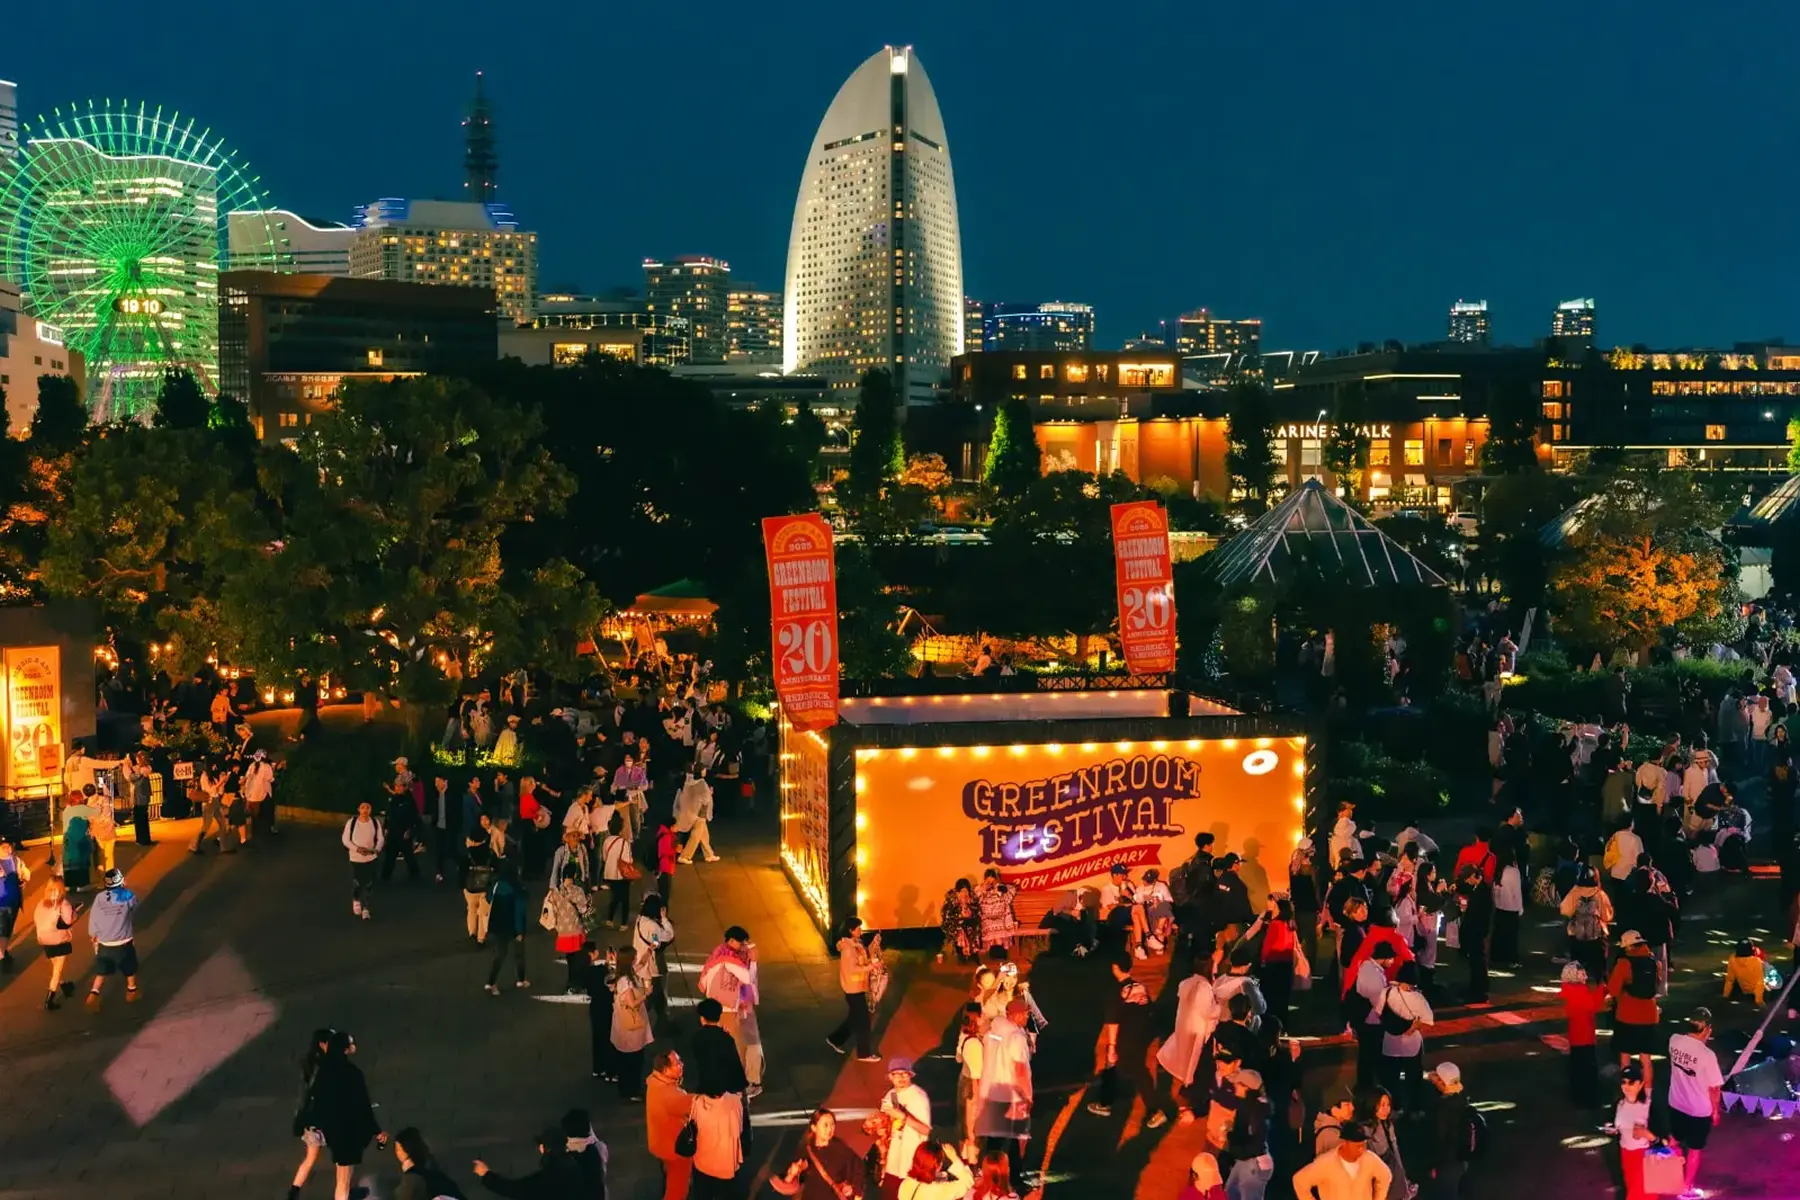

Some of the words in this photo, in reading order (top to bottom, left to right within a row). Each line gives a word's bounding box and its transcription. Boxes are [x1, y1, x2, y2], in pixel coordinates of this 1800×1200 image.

[774, 559, 830, 586] GREENROOM
[1124, 558, 1163, 580] FESTIVAL
[782, 586, 827, 613] FESTIVAL
[1124, 586, 1170, 630] 20
[779, 620, 832, 674] 20
[963, 755, 1202, 820] GREENROOM
[980, 796, 1184, 865] FESTIVAL
[1052, 849, 1147, 883] ANNIVERSARY
